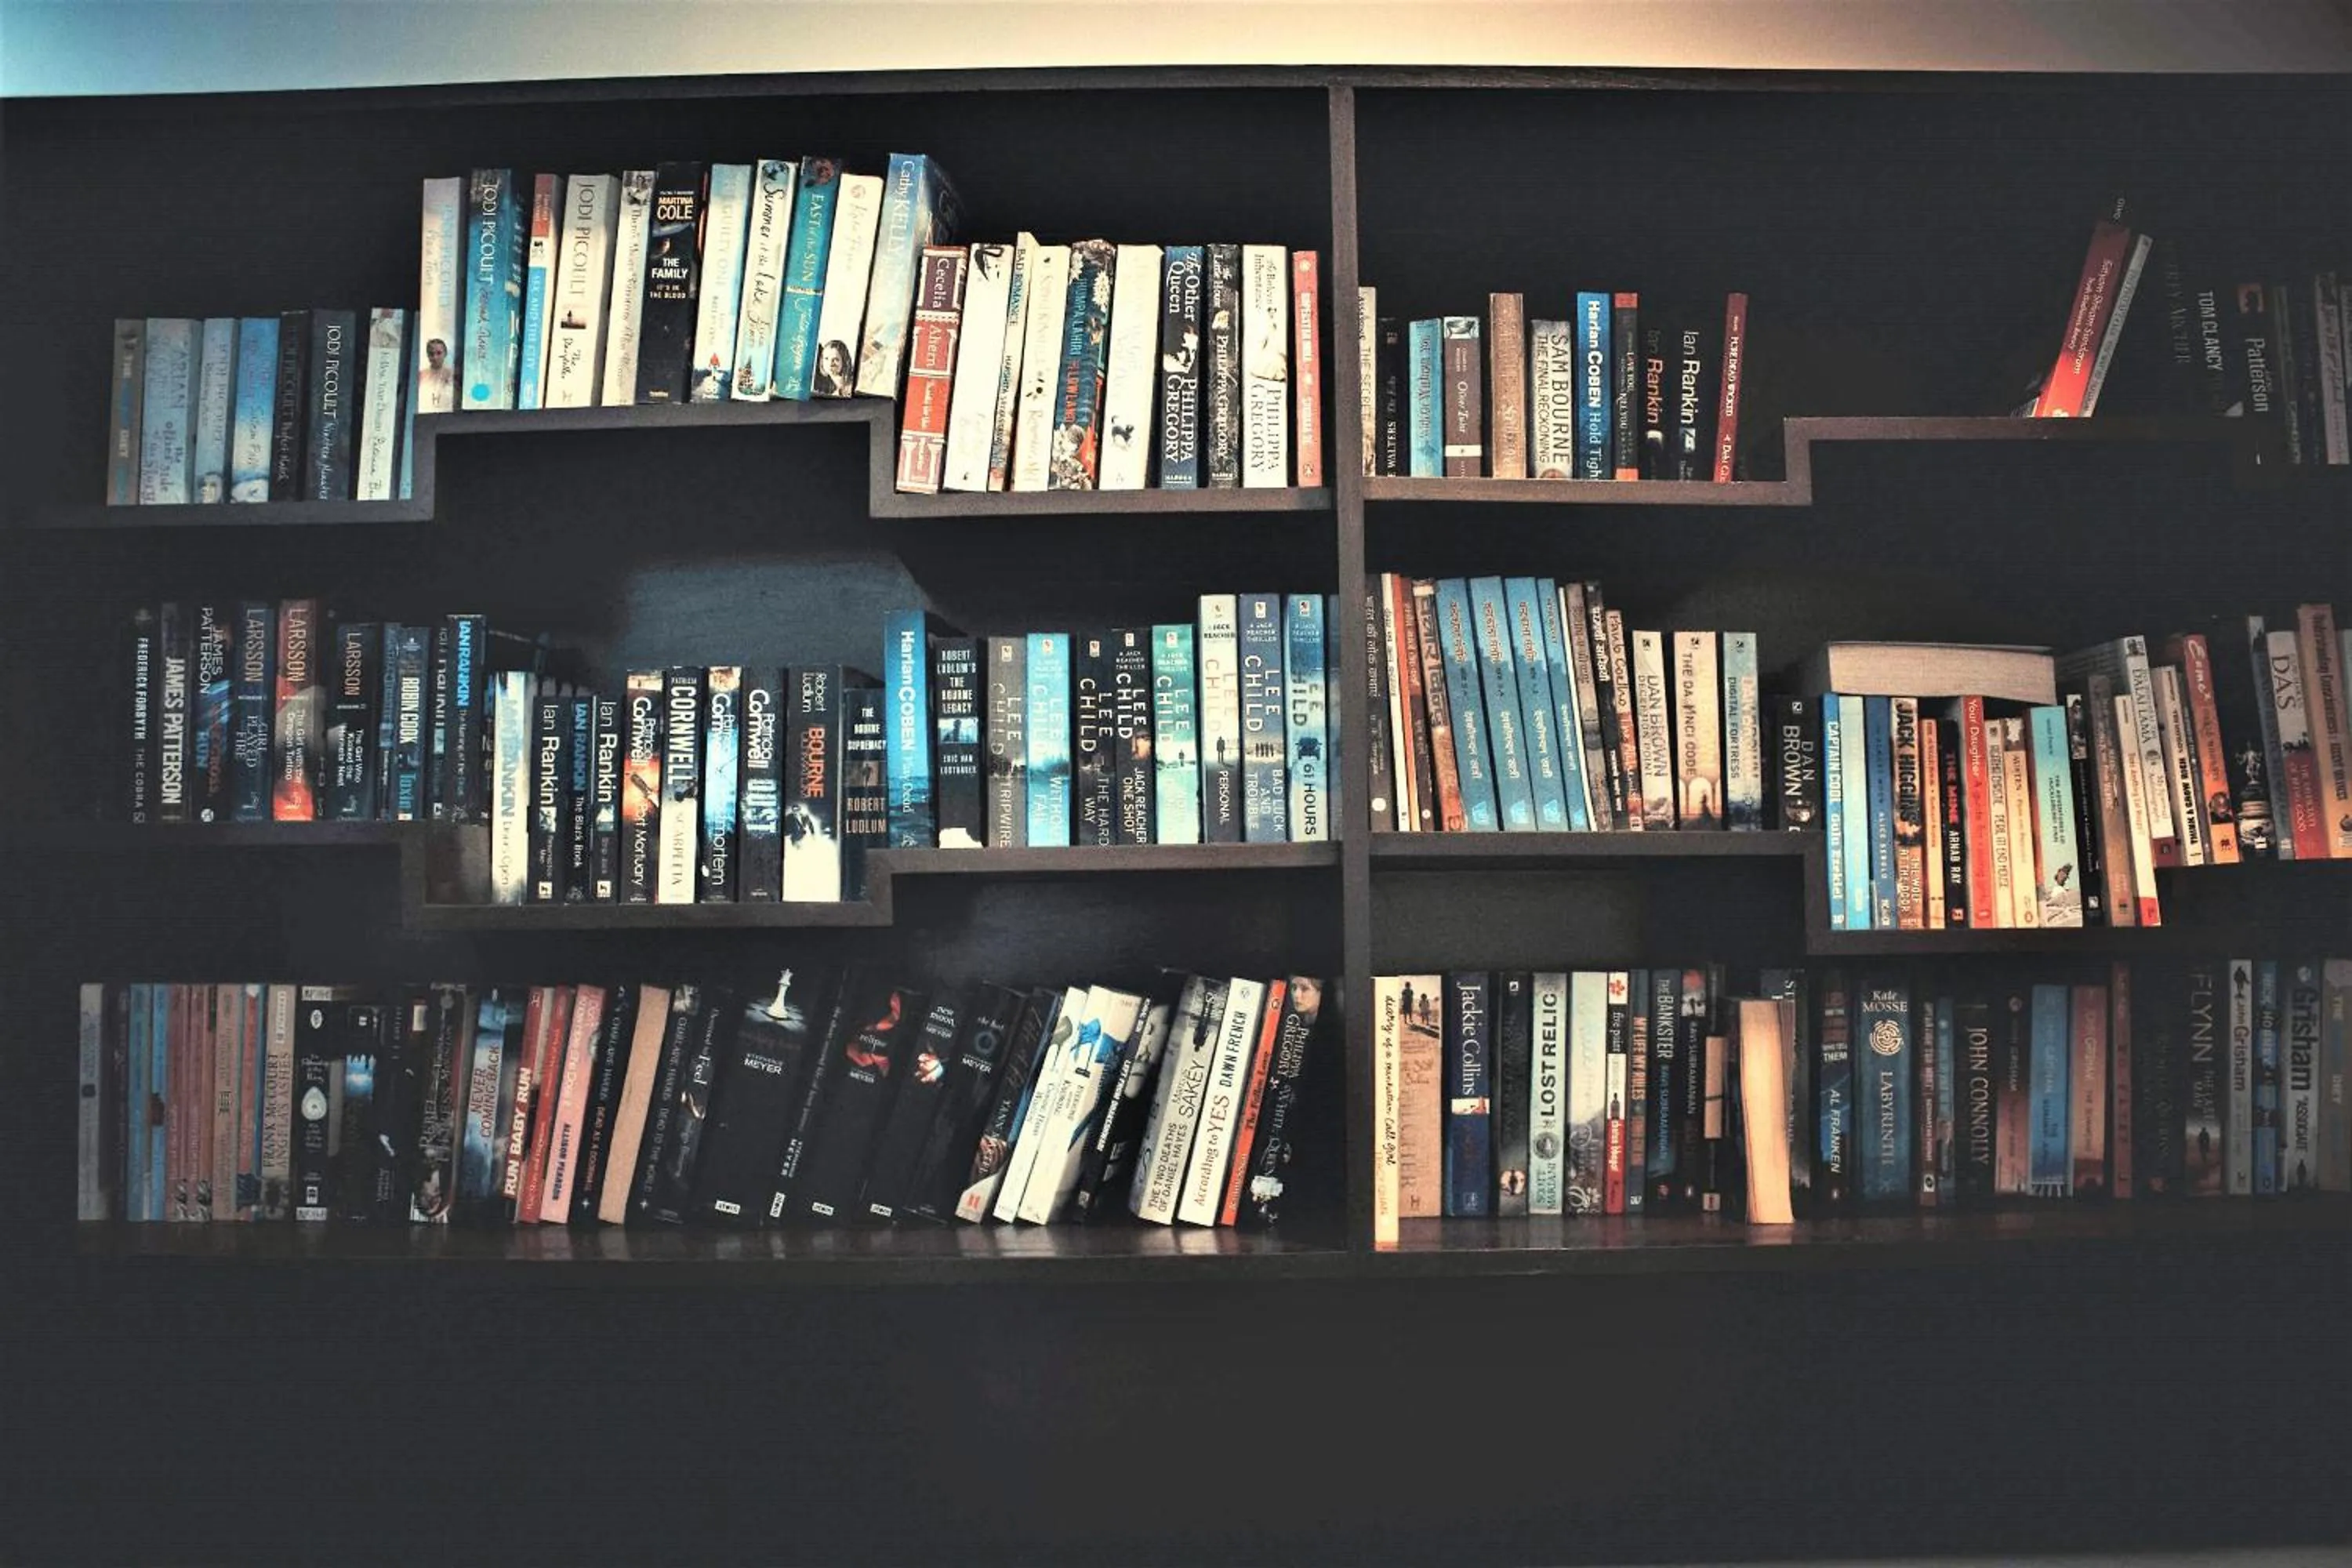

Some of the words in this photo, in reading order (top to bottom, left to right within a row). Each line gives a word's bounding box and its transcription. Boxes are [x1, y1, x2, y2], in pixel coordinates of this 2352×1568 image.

[481, 182, 499, 216] JODI
[576, 183, 595, 220] JODI
[896, 160, 915, 196] Cathy
[656, 205, 693, 220] COLE
[758, 181, 785, 239] Summer
[809, 194, 826, 227] EAST
[479, 221, 496, 285] PICOULT
[568, 226, 592, 296] PICOULT
[652, 267, 689, 280] FAMILY
[801, 252, 817, 283] SUN
[931, 257, 950, 310] Cecelia
[1008, 273, 1025, 328] ROMANCE
[1165, 260, 1185, 315] Queen
[1183, 274, 1200, 323] Other
[2196, 289, 2217, 318] TOM
[926, 325, 943, 368] Ahern
[1536, 334, 1548, 358] THE
[1586, 299, 1602, 350] Harlan
[1682, 330, 1700, 356] Ian
[2200, 321, 2226, 372] CLANCY
[1537, 358, 1549, 393] FINAL
[1549, 333, 1570, 373] SAM
[2245, 336, 2270, 413] Patterson
[1587, 350, 1603, 410] COBEN
[1646, 358, 1664, 424] Rankin
[1680, 359, 1700, 425] Rankin
[1164, 374, 1181, 465] GREGORY
[1179, 376, 1198, 463] PHILIPPA
[1249, 383, 1266, 472] GREGORY
[1265, 389, 1283, 470] PHILIPPA
[1386, 420, 1398, 469] WALTERS
[1537, 394, 1551, 464] RECKONING
[1550, 379, 1570, 464] BOURNE
[136, 637, 149, 689] FREDERICK
[198, 606, 214, 696] PATTERSON
[212, 624, 224, 677] JAMES
[243, 608, 265, 683] LARSSON
[285, 607, 309, 683] LARSSON
[343, 632, 363, 697] LARSSON
[899, 630, 916, 684] Harlan
[163, 655, 186, 709] JAMES
[399, 677, 419, 710] ROBIN
[456, 646, 471, 708] RANKIN
[1205, 658, 1221, 735] CHILD
[1222, 673, 1237, 717] LEE
[1244, 654, 1264, 733] CHILD
[1265, 669, 1281, 717] LEE
[1646, 673, 1663, 712] DAN
[2270, 655, 2297, 711] DAS
[134, 691, 148, 741] FORSYTH
[398, 712, 419, 745] COOK
[540, 704, 559, 732] Ian
[599, 701, 616, 728] Ian
[631, 696, 652, 765] Cornwell
[746, 688, 770, 769] Cornwell
[898, 684, 916, 750] COBEN
[990, 682, 1007, 755] CHILD
[1007, 697, 1022, 742] LEE
[1032, 684, 1049, 757] CHILD
[1050, 696, 1065, 741] LEE
[1080, 677, 1097, 753] CHILD
[1098, 691, 1113, 738] LEE
[1116, 671, 1134, 739] CHILD
[1132, 689, 1147, 726] LEE
[1156, 675, 1174, 743] CHILD
[1174, 690, 1190, 733] LEE
[1896, 702, 1915, 751] JACK
[2136, 707, 2153, 744] LAMA
[160, 711, 184, 805] PATTERSON
[667, 684, 698, 785] CORNWELL
[1642, 741, 1653, 778] POINT
[1650, 713, 1669, 778] BROWN
[1781, 724, 1803, 797] BROWN
[1800, 740, 1816, 782] DAN
[1966, 726, 1982, 779] Daughter
[539, 736, 560, 807] Rankin
[572, 731, 588, 792] RANKIN
[597, 732, 617, 804] Rankin
[806, 727, 826, 799] BOURNE
[1134, 768, 1145, 793] JACK
[1272, 768, 1285, 795] BAD
[1898, 753, 1919, 822] HIGGINS
[746, 779, 779, 833] DUST
[998, 777, 1014, 849] TRIPWIRE
[1083, 796, 1098, 825] WAY
[1098, 776, 1111, 807] THE
[1123, 776, 1135, 802] ONE
[1218, 770, 1230, 826] PERSONAL
[1247, 771, 1259, 831] TROUBLE
[1260, 788, 1272, 815] AND
[1272, 798, 1284, 832] LUCK
[1303, 783, 1318, 837] HOURS
[845, 818, 887, 834] LUDLUM
[1098, 808, 1111, 846] HARD
[1123, 804, 1136, 834] SHOT
[1134, 793, 1147, 846] REACHER
[1948, 830, 1960, 862] ARNAB
[1950, 866, 1962, 885] RAY
[1225, 1010, 1248, 1053] FRENCH
[1455, 979, 1482, 1036] Jackie
[1541, 993, 1559, 1055] RELIC
[1656, 995, 1675, 1059] BANKSTER
[1862, 1001, 1908, 1013] MOSSE
[2189, 974, 2215, 1062] FLYNN
[486, 1045, 500, 1082] BACK
[1964, 1026, 1988, 1071] JOHN
[2233, 1025, 2250, 1091] Grisham
[2290, 987, 2319, 1091] Grisham
[470, 1068, 488, 1113] NEVER
[516, 1066, 532, 1104] RUN
[1178, 1058, 1206, 1120] SAKEY
[1218, 1054, 1239, 1089] DAWN
[1461, 1039, 1481, 1095] Collins
[1540, 1062, 1557, 1118] LOST
[480, 1085, 497, 1138] COMING
[1828, 1088, 1841, 1105] AL
[1879, 1070, 1895, 1167] LABYRINTH
[1968, 1076, 1990, 1167] CONNOLLY
[509, 1106, 528, 1156] BABY
[1192, 1147, 1220, 1207] According
[1206, 1094, 1231, 1134] YES
[1828, 1106, 1842, 1174] FRANKEN
[503, 1160, 520, 1196] RUN
